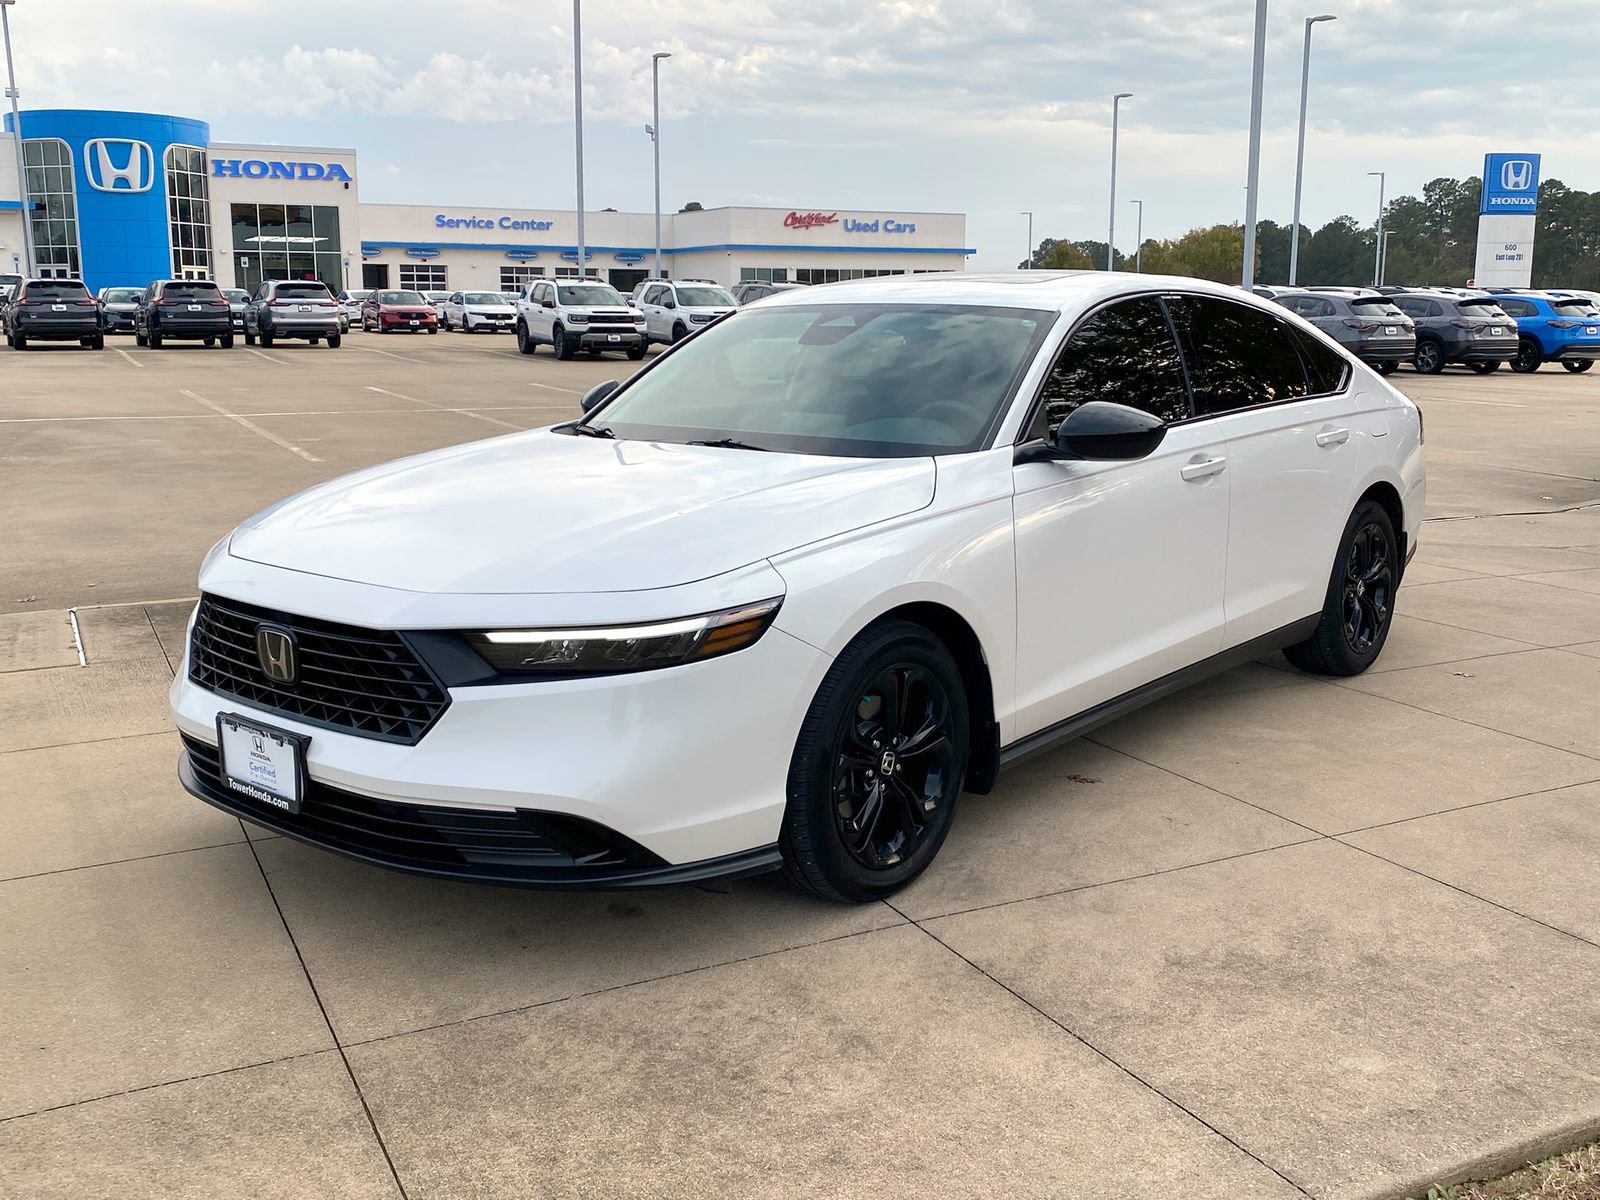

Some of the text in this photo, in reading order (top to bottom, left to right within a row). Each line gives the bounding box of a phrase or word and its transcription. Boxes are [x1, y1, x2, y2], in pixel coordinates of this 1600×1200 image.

[211, 159, 352, 181] HONDA
[1490, 197, 1536, 205] HONDA
[435, 214, 553, 231] Service Center
[783, 211, 916, 233] Certified Used Cars
[1504, 243, 1517, 251] 600
[1495, 253, 1505, 261] East
[1505, 253, 1515, 261] Loop
[250, 751, 271, 762] HONDA
[249, 761, 276, 778] Certified
[228, 777, 289, 810] TowerHonda.com
